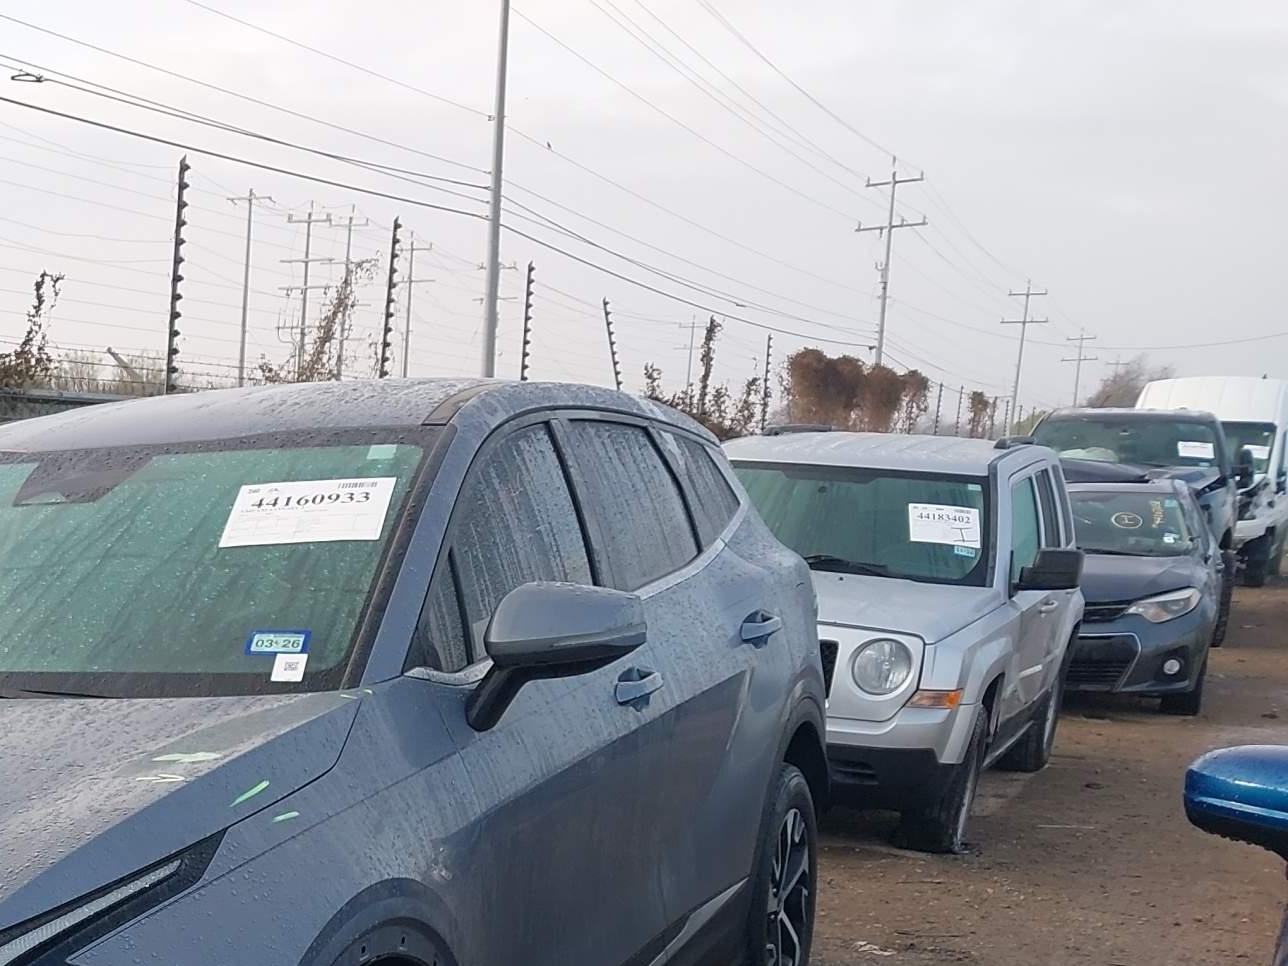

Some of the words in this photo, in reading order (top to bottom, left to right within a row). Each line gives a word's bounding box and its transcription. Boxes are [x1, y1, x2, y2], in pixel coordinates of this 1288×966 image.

[251, 491, 372, 509] 44160933
[916, 511, 972, 525] 44183402
[255, 639, 274, 649] 03
[281, 639, 301, 649] 26
